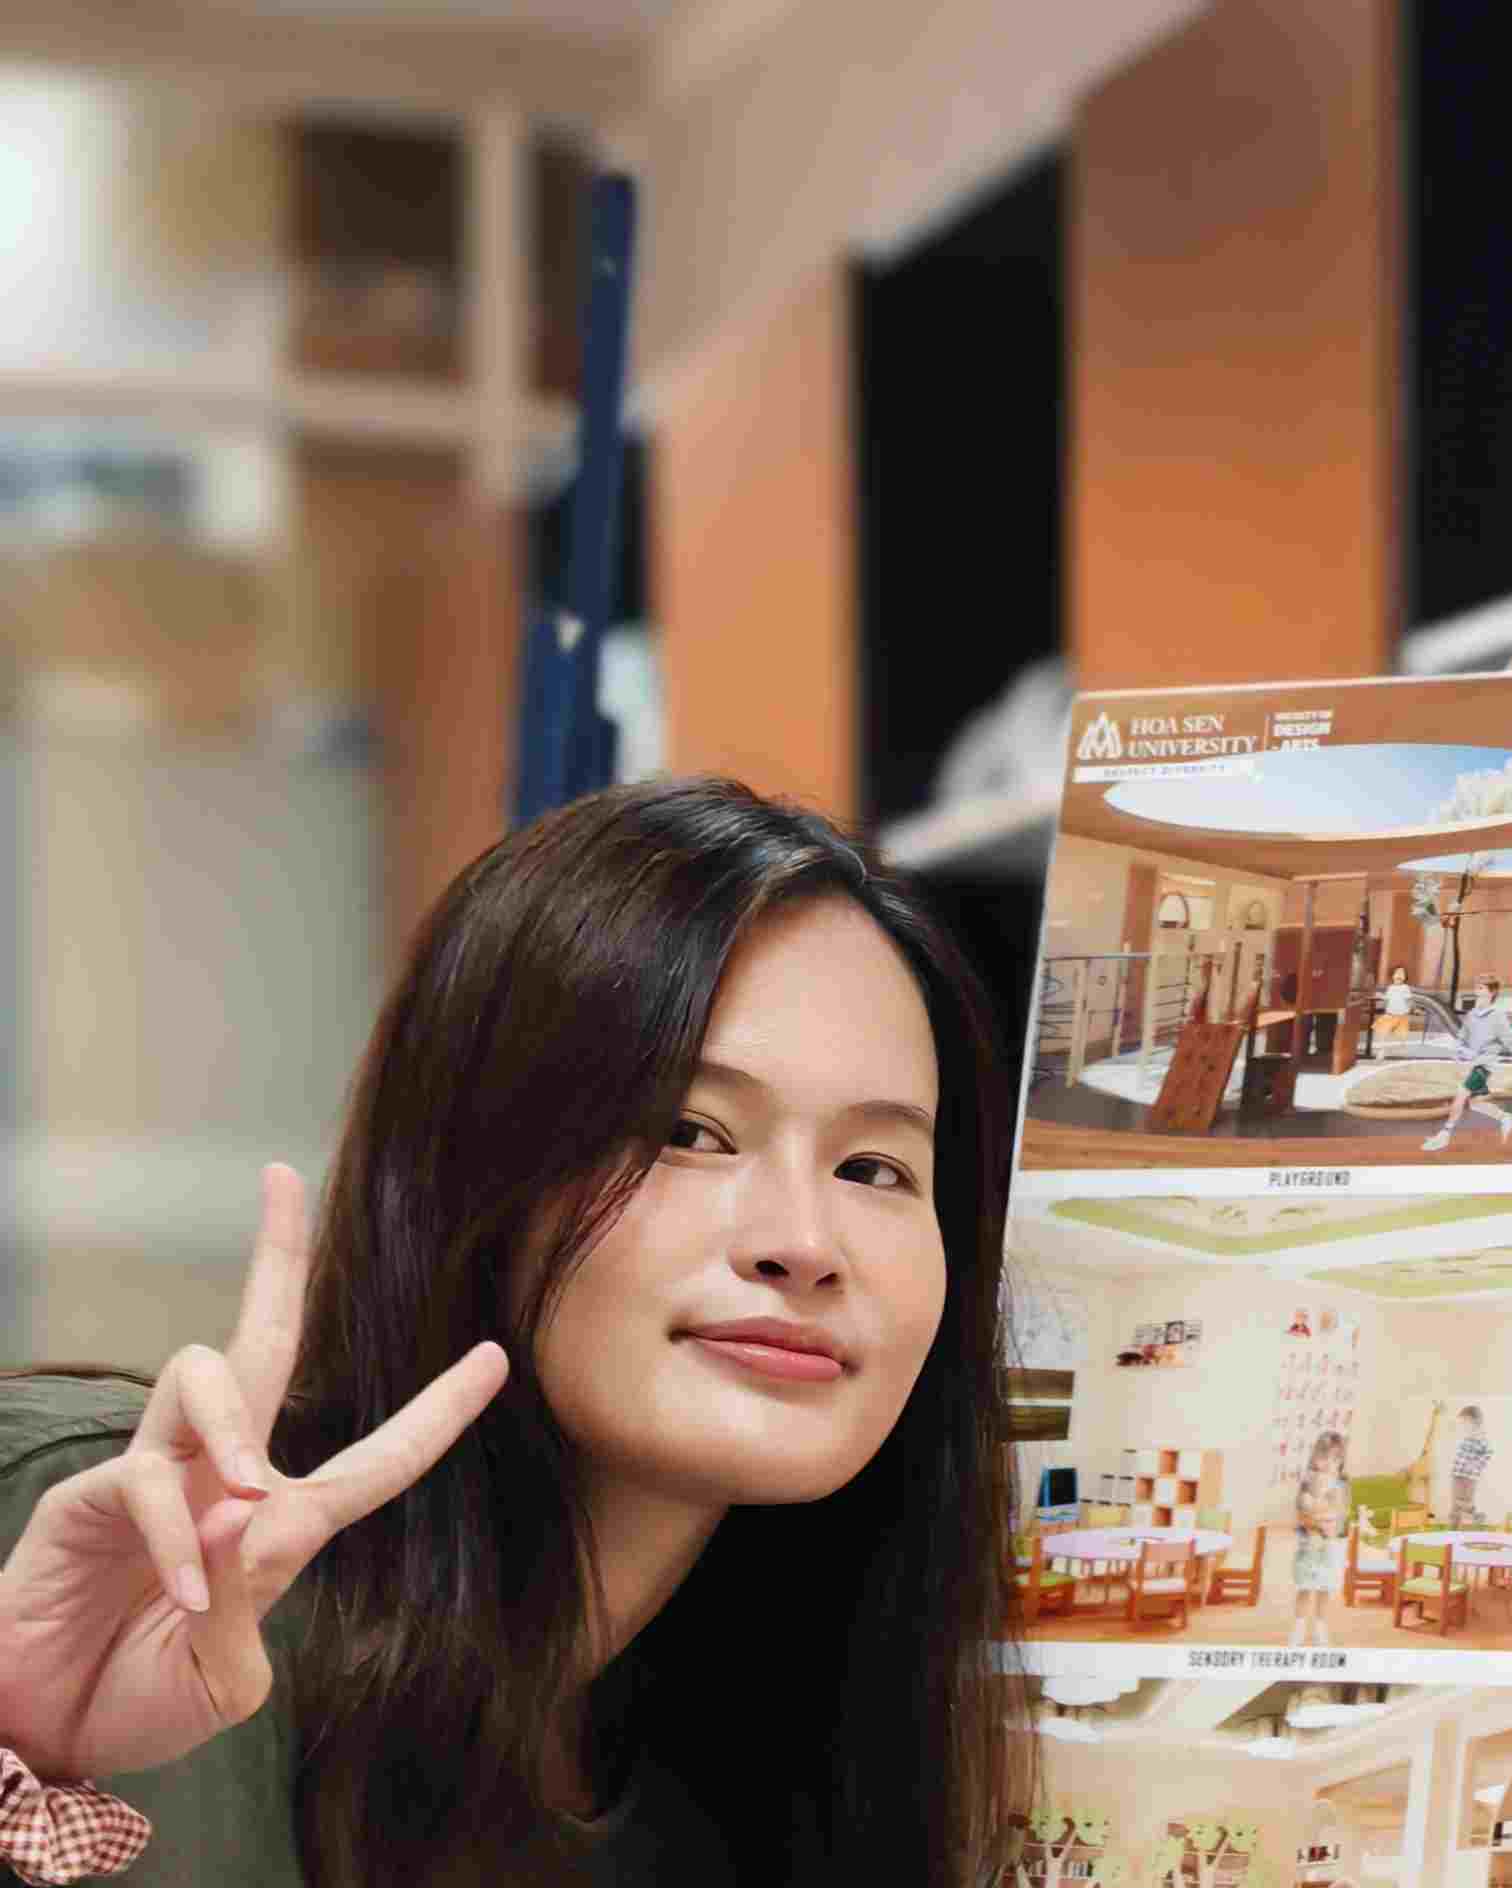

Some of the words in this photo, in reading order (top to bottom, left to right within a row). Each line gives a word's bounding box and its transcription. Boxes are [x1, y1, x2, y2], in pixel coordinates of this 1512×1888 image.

[1130, 715, 1178, 736] HOA
[1183, 713, 1225, 733] SEN
[1128, 736, 1257, 758] UNIVERSITY
[1280, 738, 1320, 752] ARTS
[1269, 1171, 1351, 1186] PLAYGROUND
[1189, 1651, 1245, 1667] SENSORY
[1251, 1651, 1306, 1667] THERAPY
[1311, 1652, 1347, 1668] ROOM
